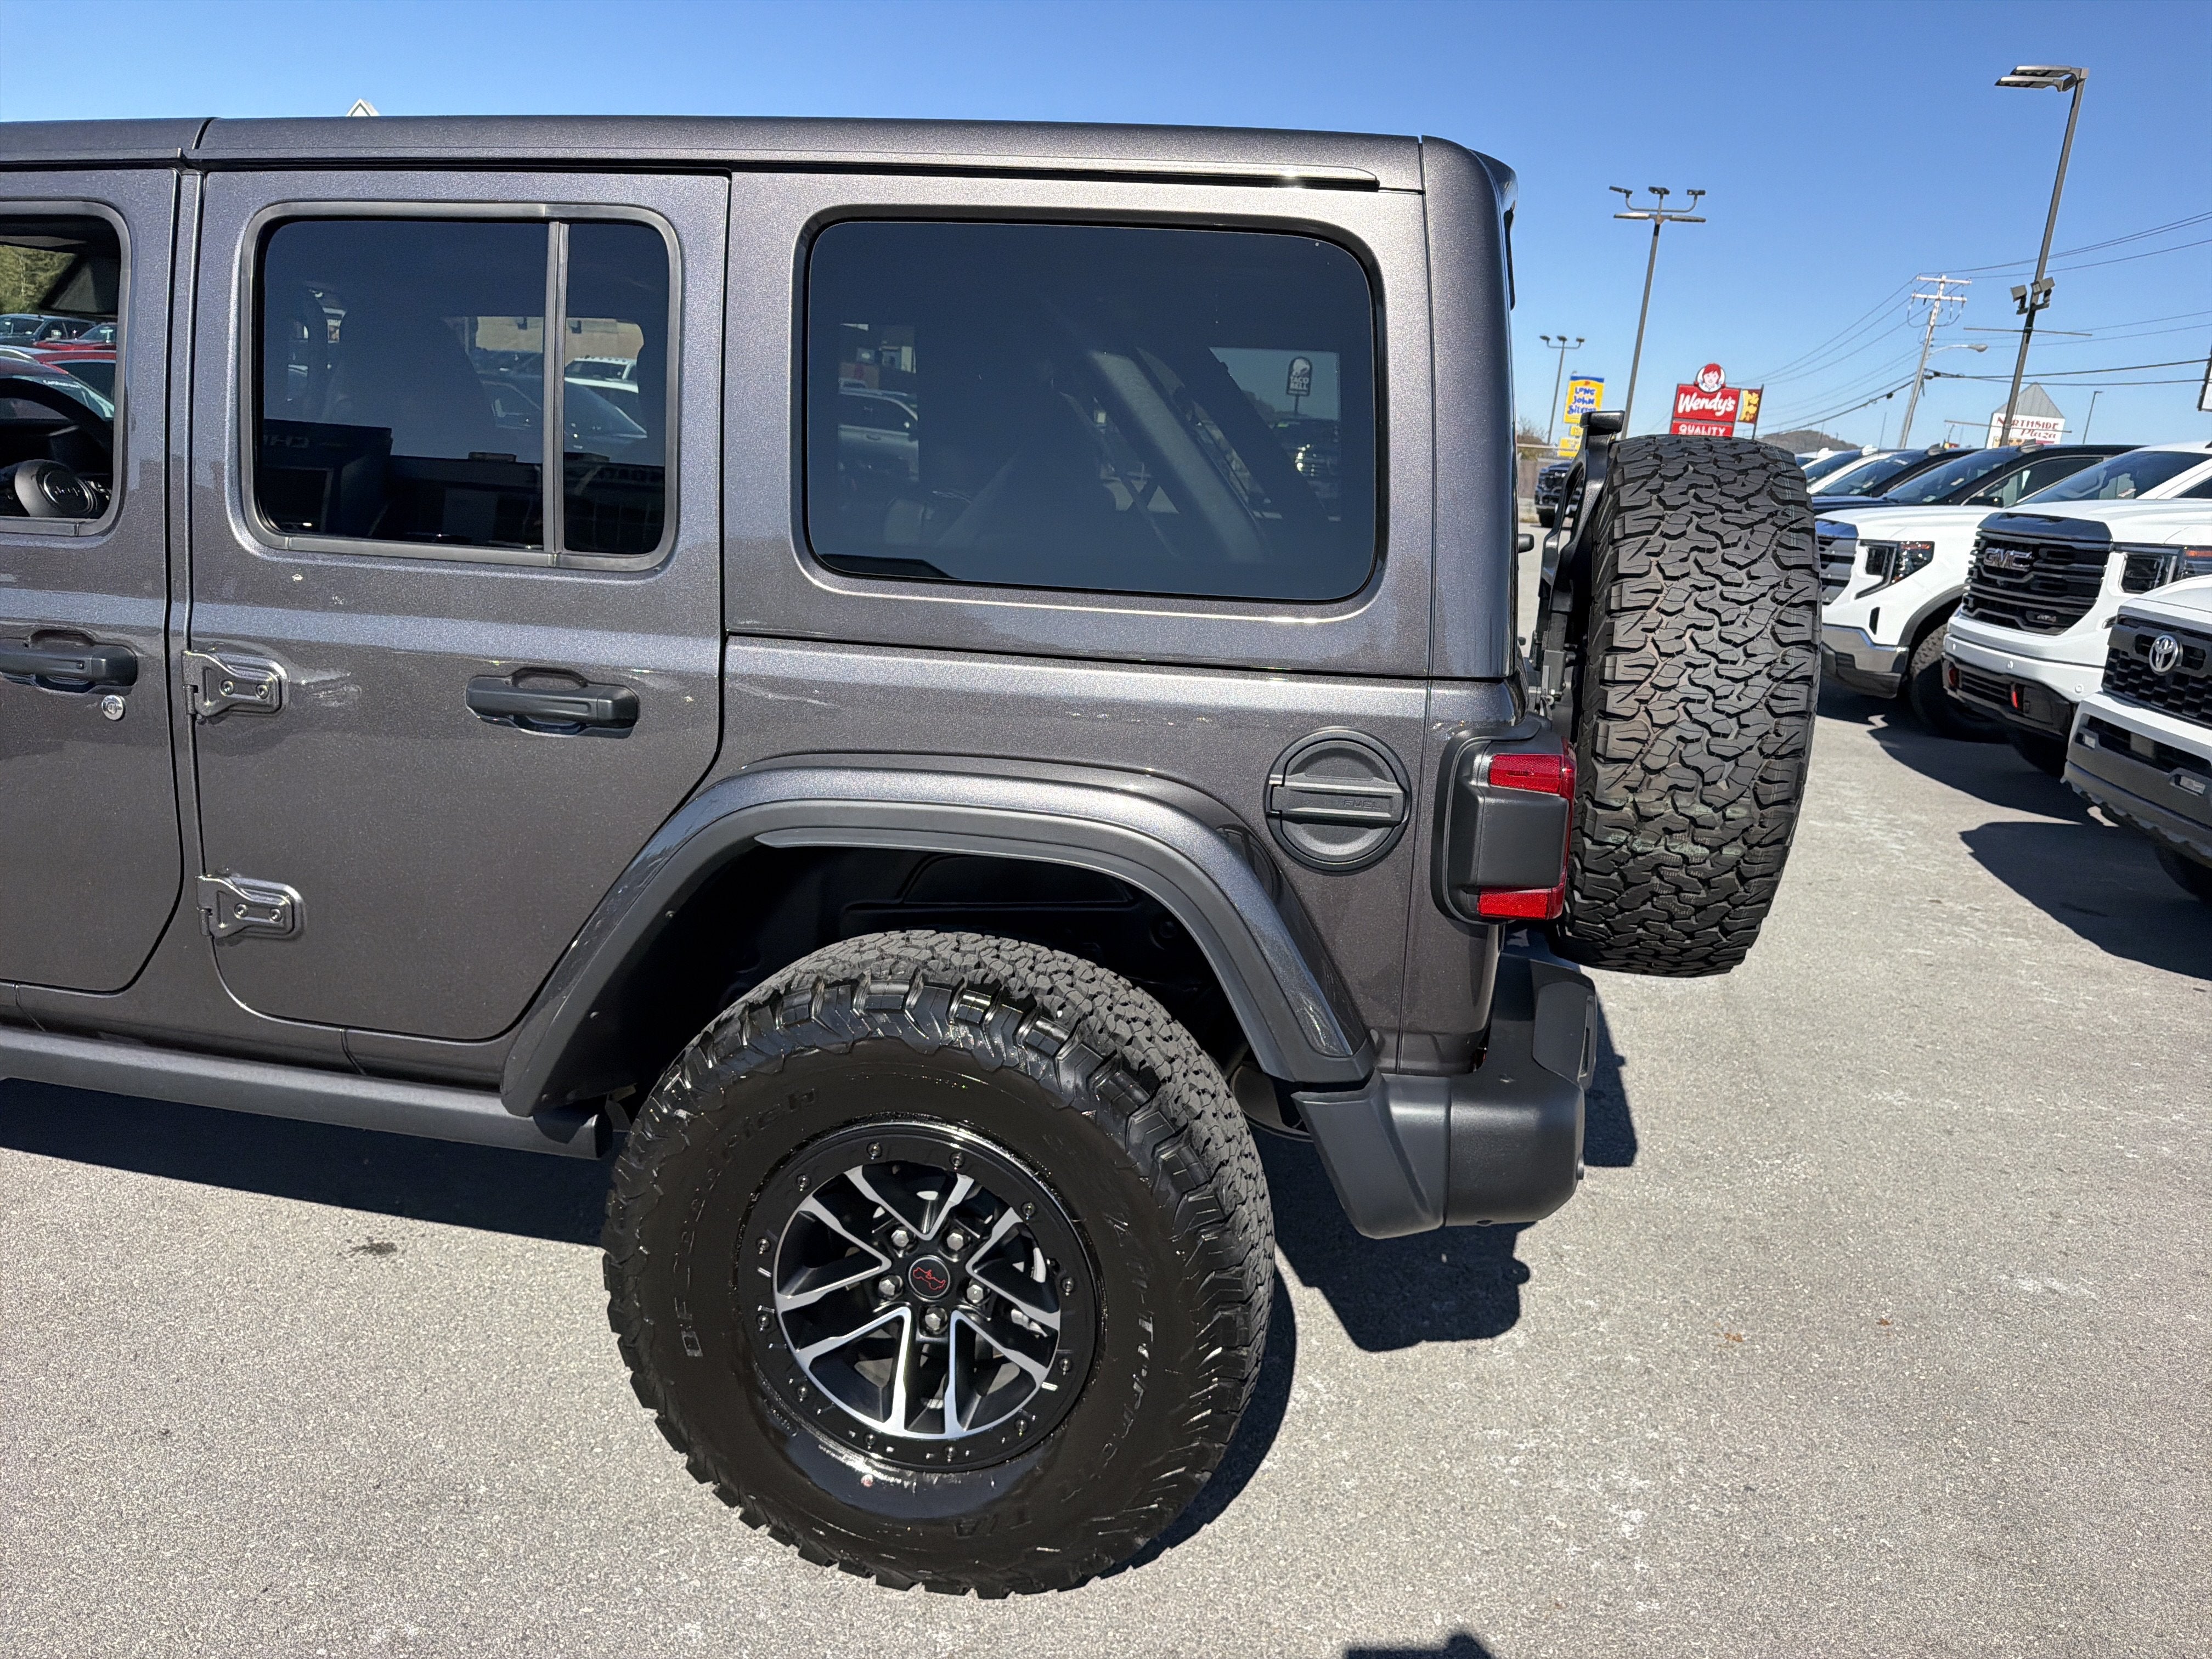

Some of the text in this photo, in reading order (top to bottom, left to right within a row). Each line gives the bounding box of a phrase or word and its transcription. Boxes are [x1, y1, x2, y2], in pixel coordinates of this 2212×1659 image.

[1290, 376, 1310, 384] TACO
[1678, 391, 1736, 417] Wendy's
[1996, 416, 2059, 430] NRTHSIDE
[1678, 424, 1726, 436] QUALITY
[1983, 548, 2033, 572] GMC
[1343, 799, 1381, 810] FUEL
